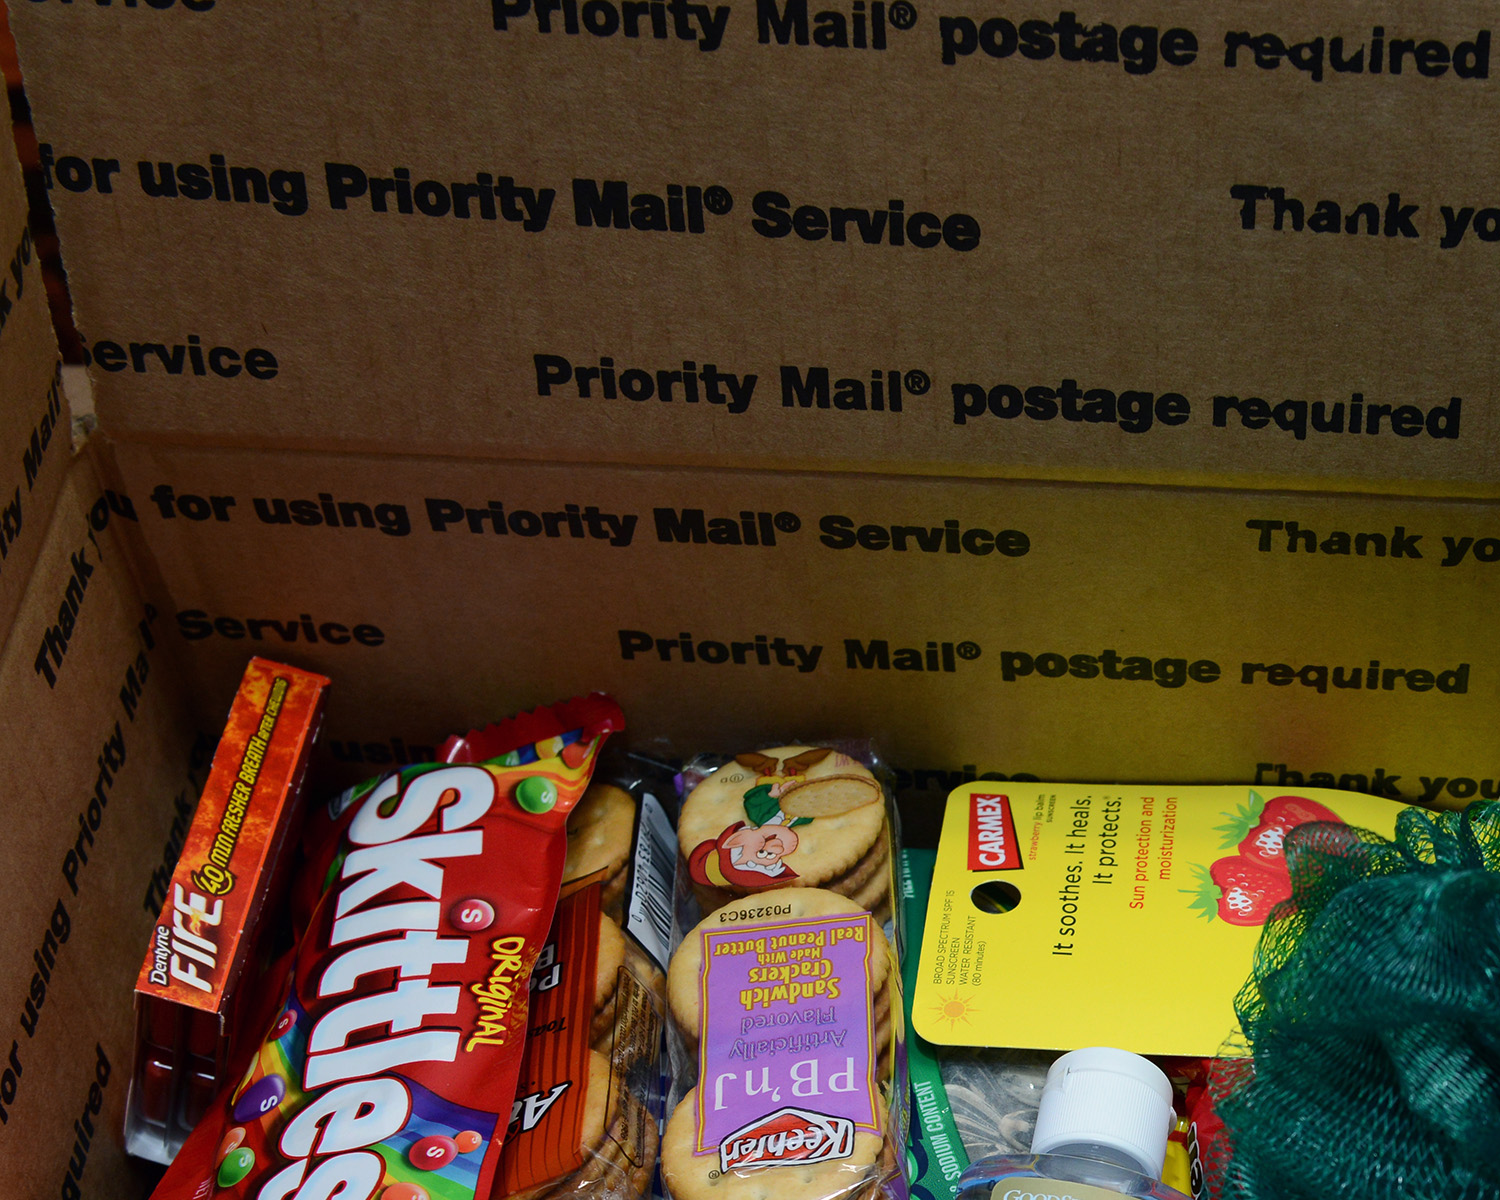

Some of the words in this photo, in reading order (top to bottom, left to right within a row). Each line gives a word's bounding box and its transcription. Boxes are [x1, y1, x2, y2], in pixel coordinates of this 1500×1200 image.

[492, 0, 730, 51] Priority
[941, 12, 1198, 74] postage
[1224, 26, 1491, 81] required
[39, 144, 120, 194] for
[138, 154, 308, 216] using
[325, 162, 555, 232] Priority
[752, 191, 980, 251] Service
[1230, 184, 1419, 238] Thank
[533, 354, 757, 413] Priority
[951, 379, 1190, 433] postage
[1212, 393, 1462, 440] required
[1246, 519, 1423, 559] Thank
[34, 547, 94, 689] Thank
[150, 484, 236, 522] for
[253, 493, 410, 536] using
[425, 497, 638, 546] Priority
[818, 516, 1031, 557] Service
[618, 630, 823, 673] Priority
[1000, 649, 1221, 688] postage
[1240, 659, 1470, 695] required
[62, 721, 126, 895] Priority
[175, 609, 385, 646] Service
[238, 735, 267, 785] BREATH
[222, 781, 253, 838] FRESHER
[1066, 795, 1092, 839] heals.
[1141, 796, 1155, 818] and
[210, 836, 235, 869] MIN
[978, 795, 1006, 867] CARMEX
[1159, 795, 1178, 881] moisturization
[1135, 819, 1152, 889] protection
[201, 866, 225, 893] 40
[1058, 860, 1083, 938] soothes.
[1129, 889, 1144, 909] Sun
[719, 903, 792, 922] P03236C3
[830, 925, 865, 942] Real
[963, 915, 977, 953] RESISTANT
[149, 925, 171, 987] Dentyne
[714, 936, 766, 957] Butter
[770, 930, 825, 949] Peanut
[790, 947, 821, 959] Made
[937, 913, 951, 957] SPECTRUM
[1052, 943, 1073, 957] It
[21, 899, 71, 1038] using
[748, 959, 833, 984] Crackers
[757, 951, 787, 964] With
[933, 957, 943, 985] BROAD
[946, 936, 960, 985] SUNSCREEN
[958, 954, 970, 986] WATER
[739, 977, 841, 1011] Sandwich
[740, 1005, 837, 1035] Flavored
[729, 1028, 848, 1061] Artificially
[914, 1080, 942, 1131] CONTENT
[721, 1119, 854, 1171] Keebler
[934, 1131, 962, 1182] SODIUM
